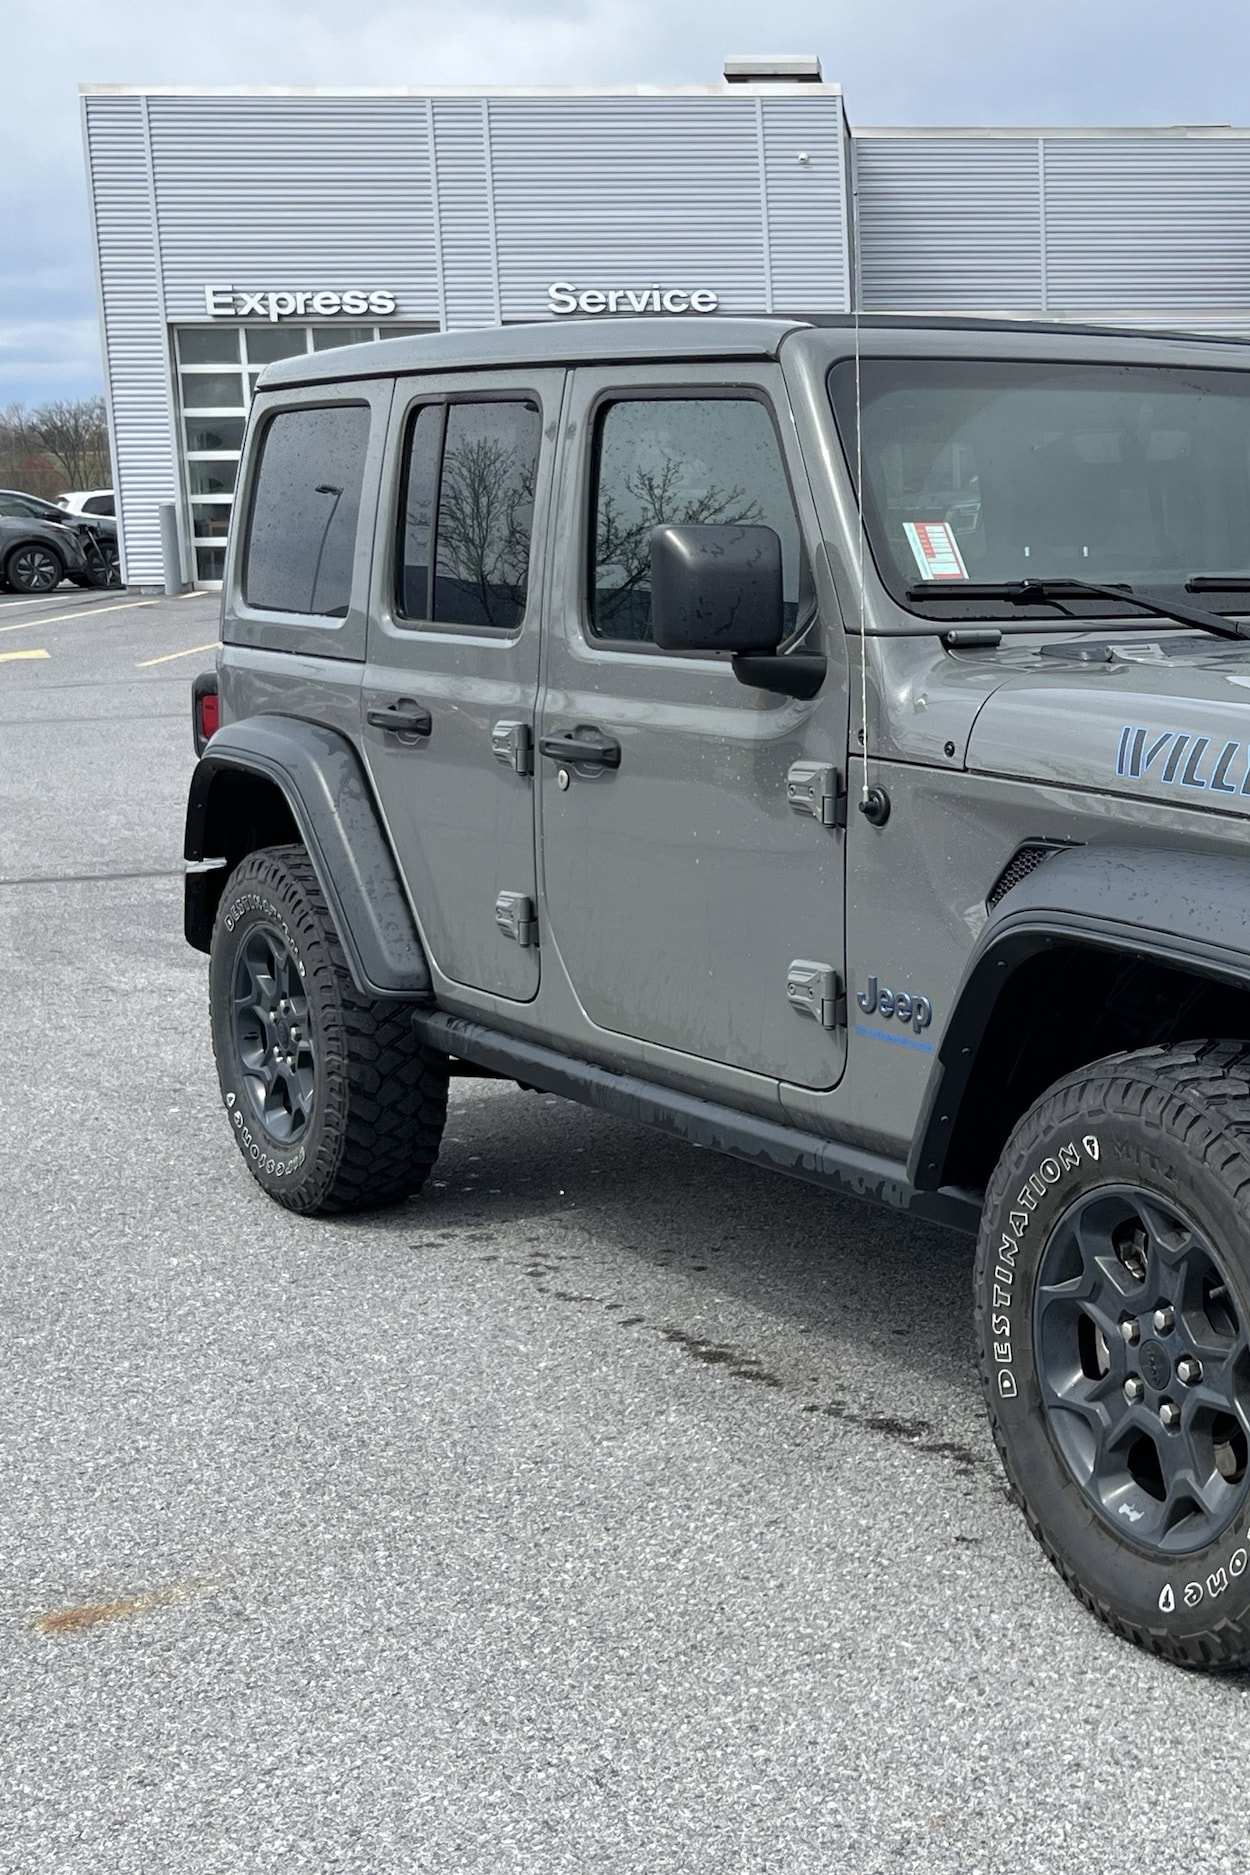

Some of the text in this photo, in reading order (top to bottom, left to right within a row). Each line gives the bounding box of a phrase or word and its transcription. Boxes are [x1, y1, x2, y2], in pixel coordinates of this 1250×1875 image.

[204, 284, 395, 322] Express
[549, 281, 717, 315] Service
[857, 974, 932, 1033] Jeep
[991, 1140, 1082, 1398] DESTINATION
